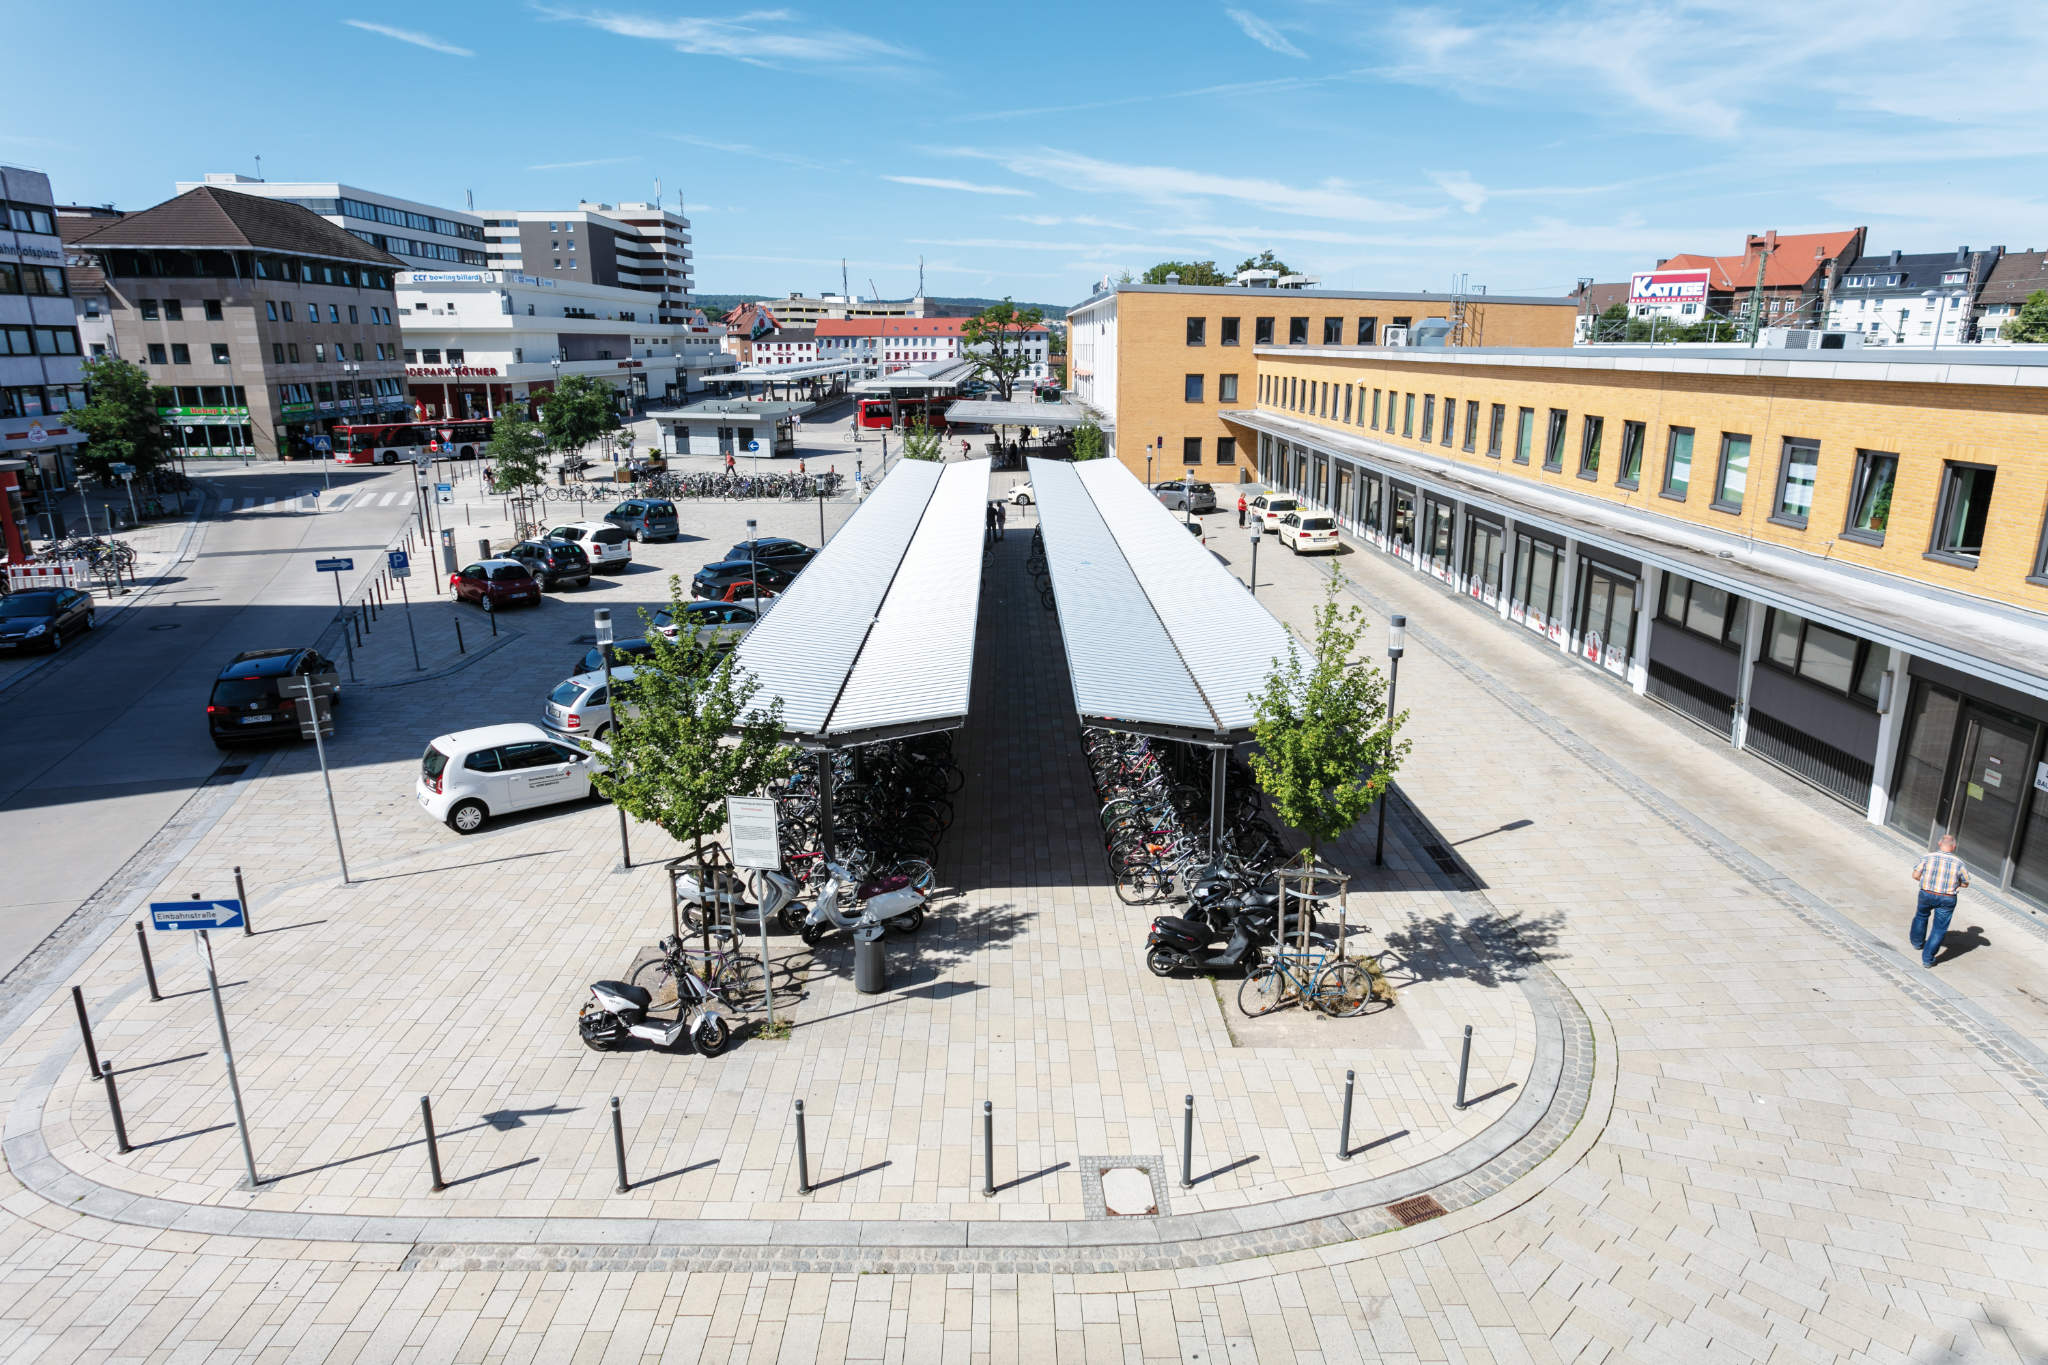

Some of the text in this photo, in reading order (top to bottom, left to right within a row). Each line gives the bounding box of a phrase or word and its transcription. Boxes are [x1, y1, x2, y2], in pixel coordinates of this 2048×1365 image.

[429, 275, 456, 283] bowling
[393, 554, 404, 567] P
[156, 911, 216, 921] Einbahnstraße
